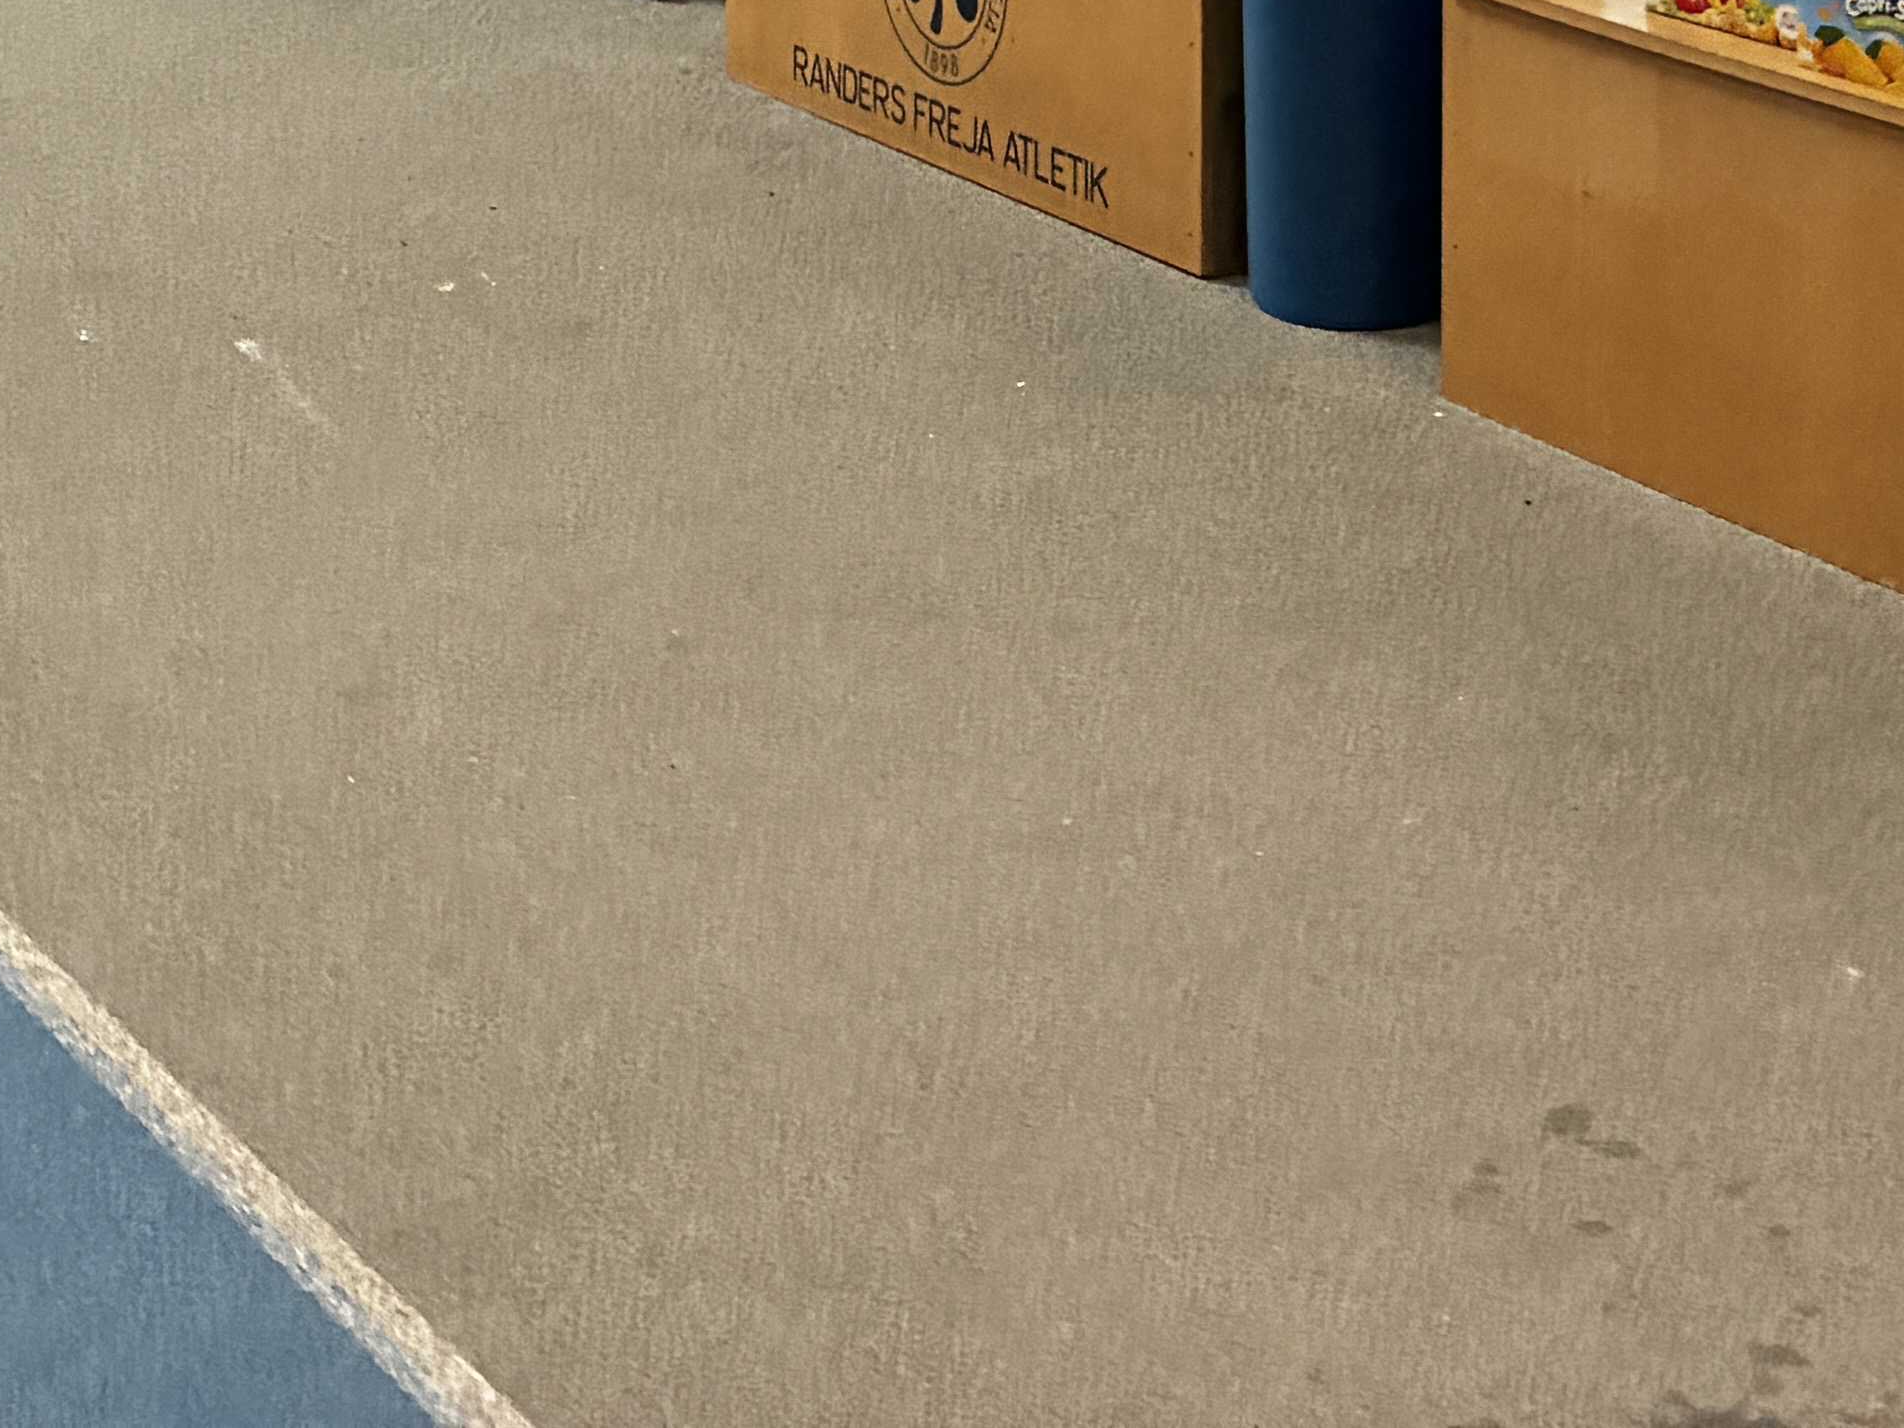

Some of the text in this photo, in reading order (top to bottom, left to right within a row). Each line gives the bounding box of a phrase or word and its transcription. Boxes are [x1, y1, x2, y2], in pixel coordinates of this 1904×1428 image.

[924, 42, 960, 78] 1898
[793, 44, 1109, 210] RANDERS FREJA ATLETIK
